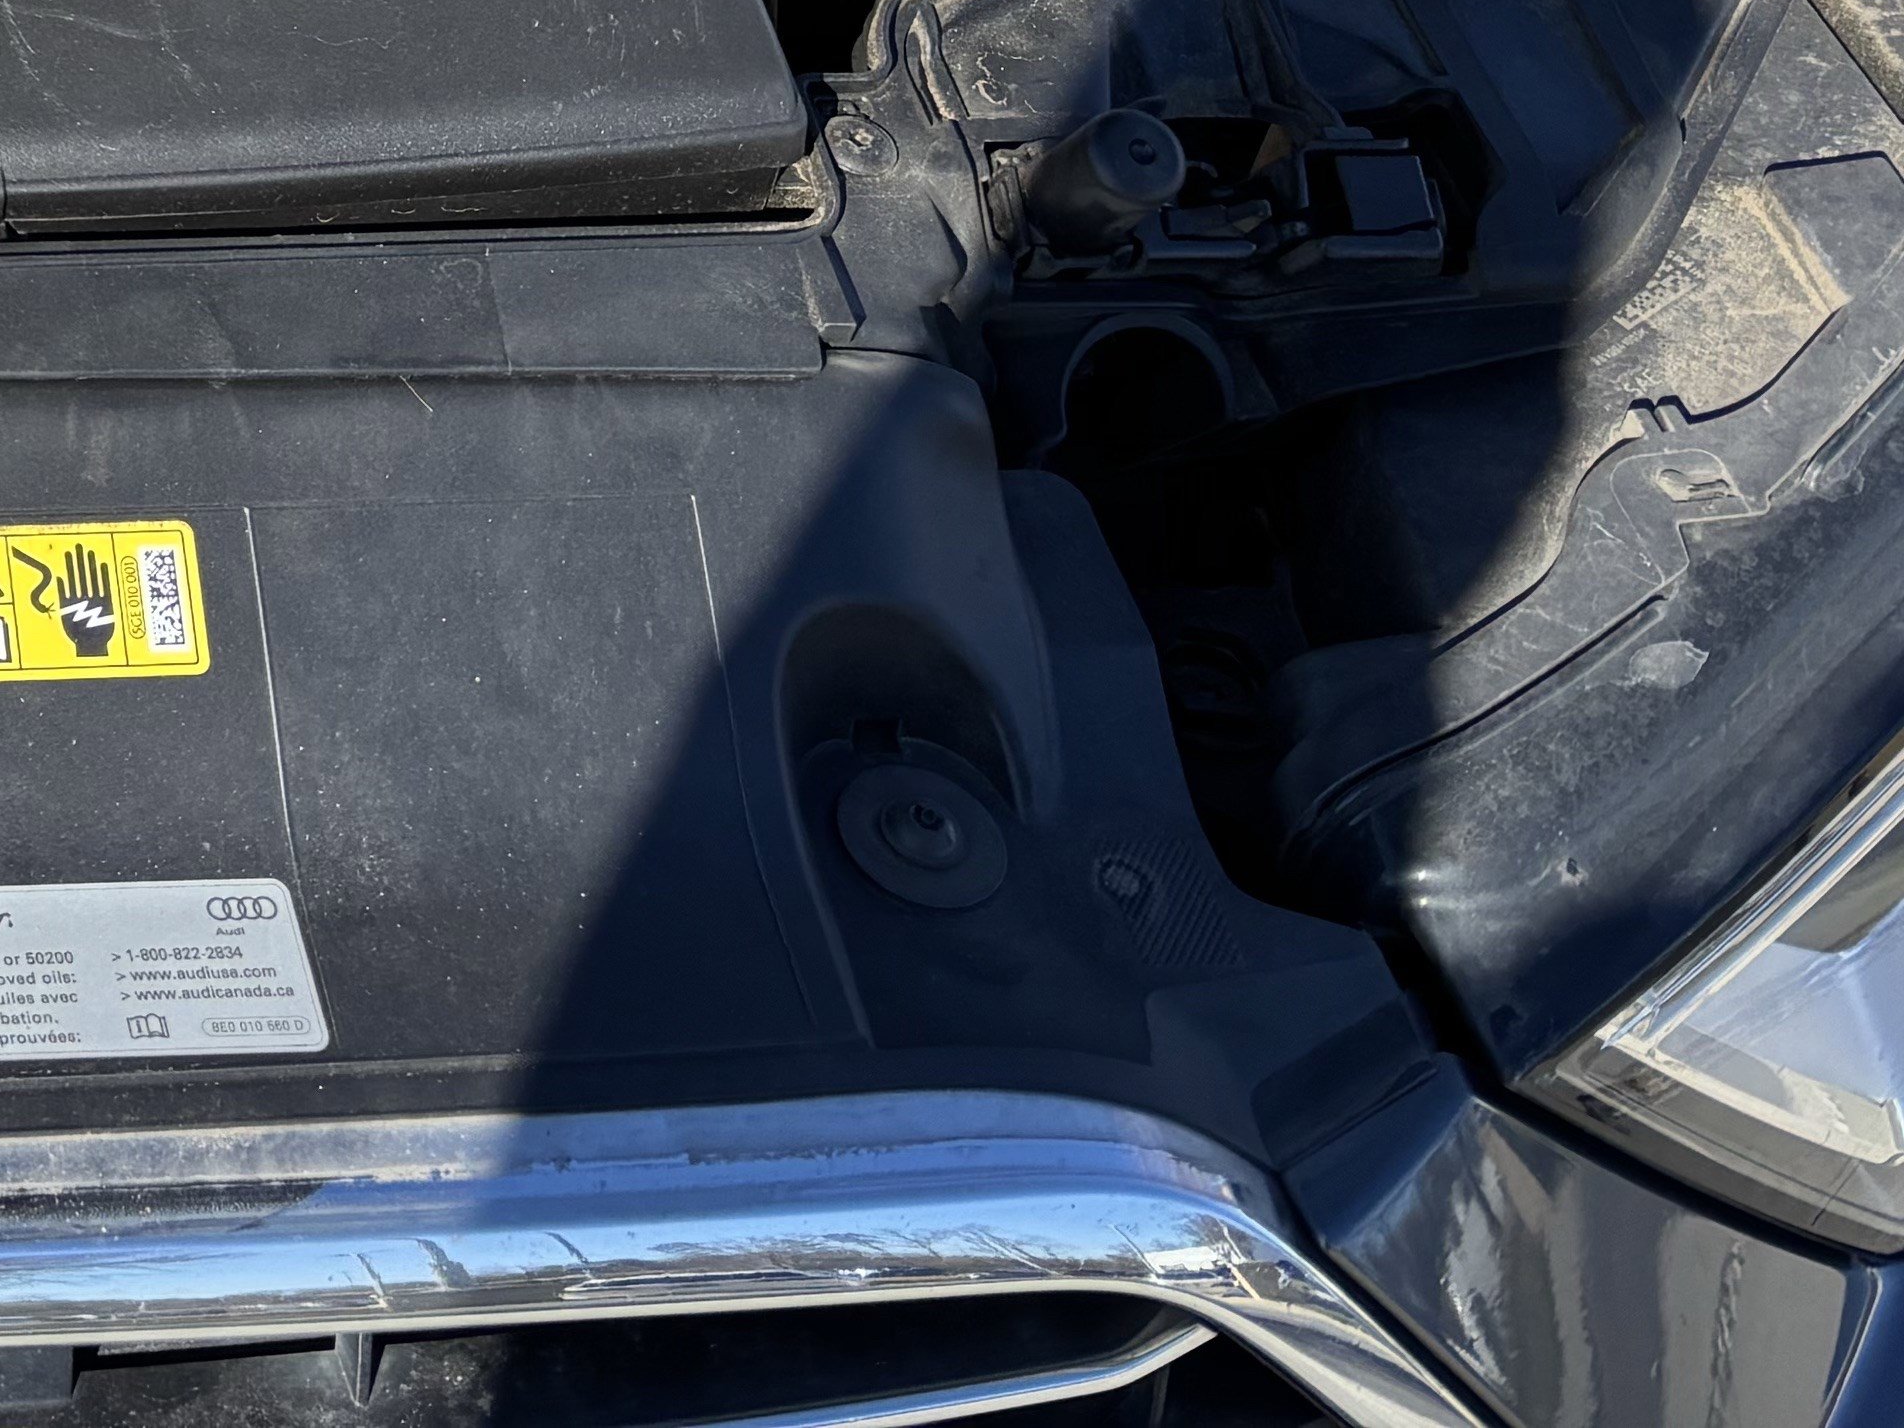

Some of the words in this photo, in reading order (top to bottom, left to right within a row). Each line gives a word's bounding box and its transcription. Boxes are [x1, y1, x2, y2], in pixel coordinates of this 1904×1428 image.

[216, 927, 245, 935] Audi
[4, 956, 20, 965] or
[26, 951, 73, 964] 50200
[126, 946, 243, 962] 1-800-822-2834
[42, 971, 76, 984] oils:
[129, 966, 276, 981] www.audiusa.com
[41, 993, 78, 1003] avec
[135, 984, 294, 1000] www.audicanada.ca
